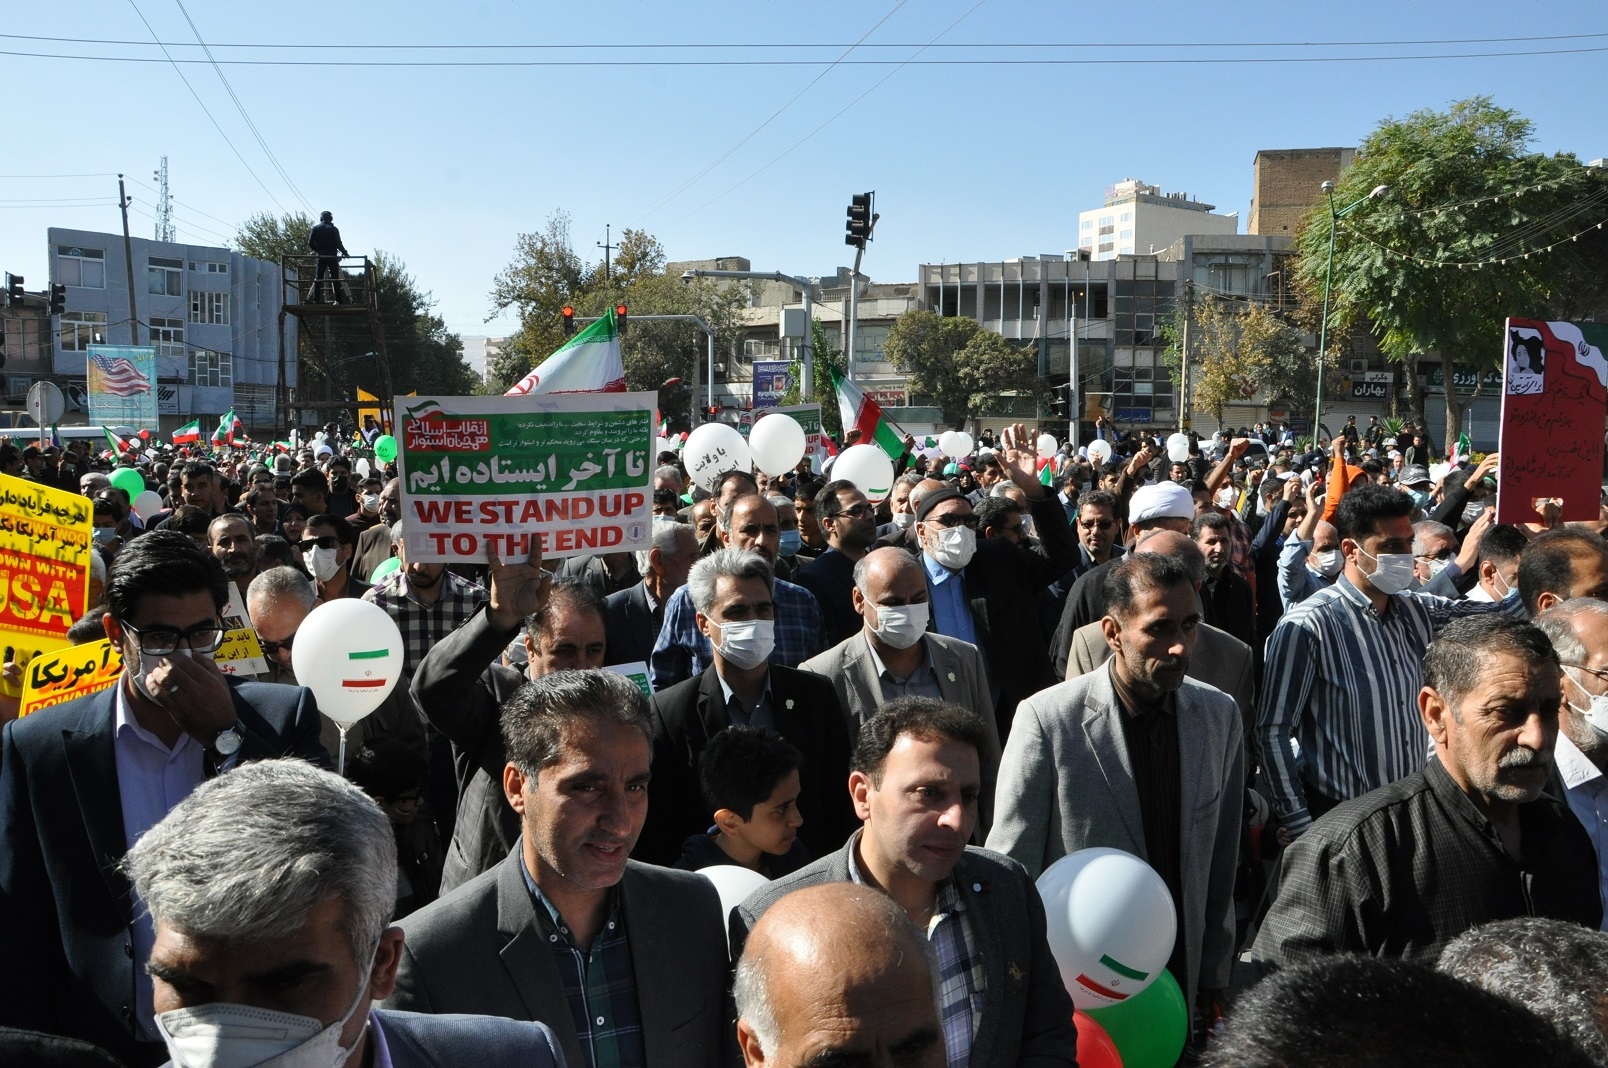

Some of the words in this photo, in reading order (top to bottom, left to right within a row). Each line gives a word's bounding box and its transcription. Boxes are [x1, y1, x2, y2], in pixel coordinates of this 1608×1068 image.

[1453, 371, 1495, 385] کاورزی
[1354, 383, 1386, 397] بهاران
[407, 419, 447, 435] اسلامی
[447, 420, 487, 435] انقلاب
[408, 433, 447, 449] استوار
[446, 433, 488, 450] همچنان
[808, 435, 819, 444] UP
[716, 447, 727, 458] با
[455, 453, 557, 490] ایستاده
[561, 447, 621, 490] آخر
[625, 450, 645, 478] تا
[410, 456, 451, 493] ایم
[0, 490, 17, 507] دار
[19, 495, 51, 516] فریاد
[413, 500, 474, 524] WE
[479, 497, 595, 525] STAND
[598, 493, 645, 518] UP
[69, 512, 86, 525] هر
[16, 520, 57, 544] آمریکا
[58, 539, 75, 550] سر
[76, 541, 88, 555] بر
[429, 533, 478, 556] TO
[555, 525, 624, 552] END
[236, 631, 251, 643] باید
[227, 647, 240, 660] این
[242, 646, 249, 659] از
[31, 643, 112, 691] آمریکا
